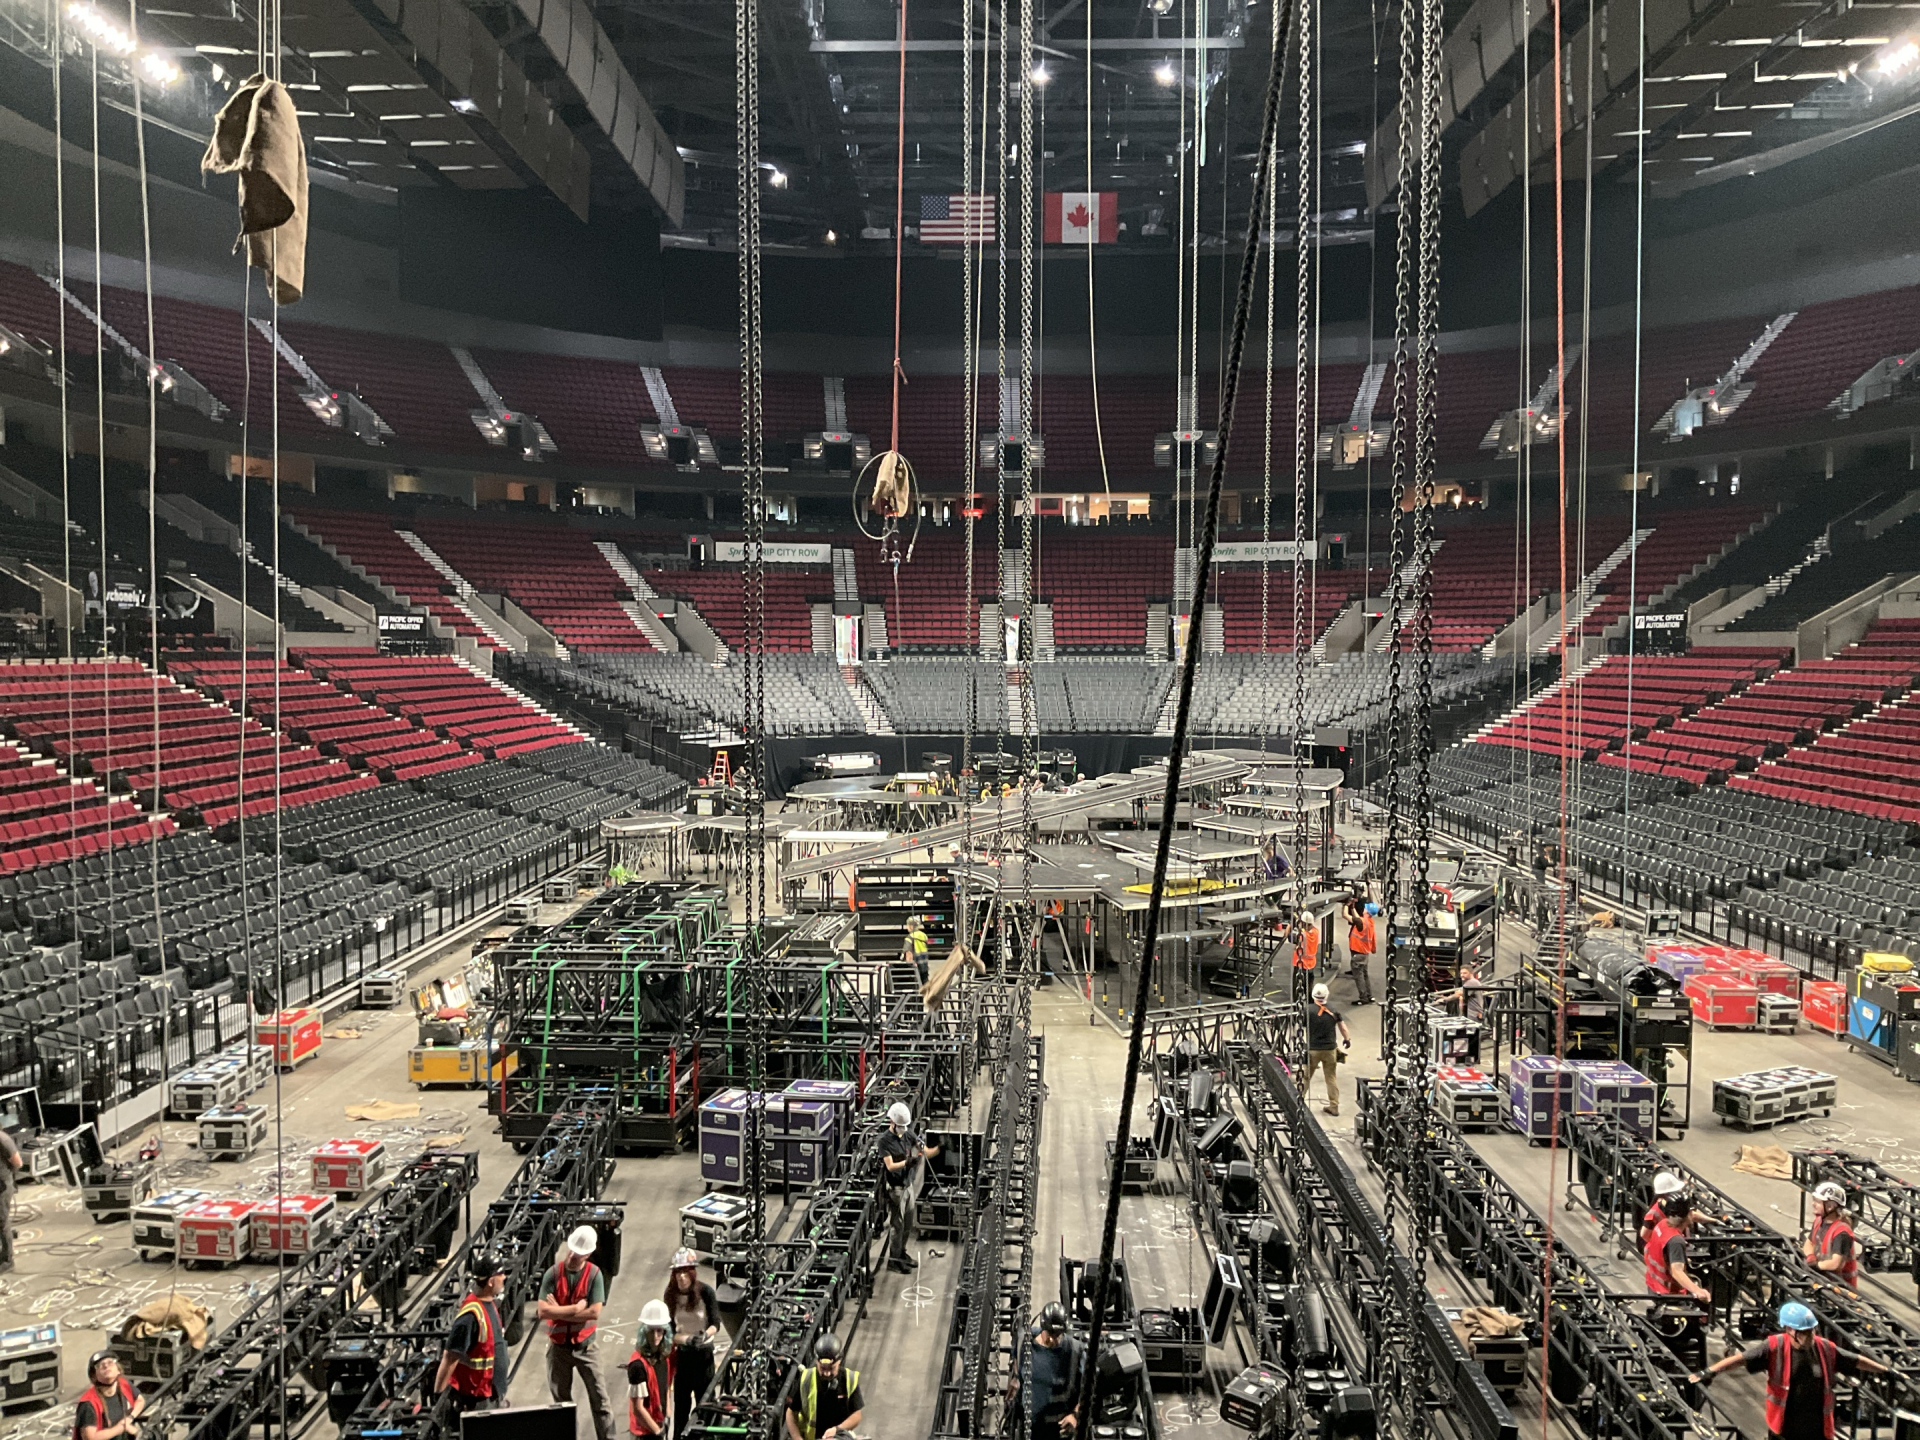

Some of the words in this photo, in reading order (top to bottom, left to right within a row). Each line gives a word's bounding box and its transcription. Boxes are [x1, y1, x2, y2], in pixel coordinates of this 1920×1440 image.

[728, 547, 753, 557] Sprie
[761, 548, 774, 557] RIP
[777, 548, 796, 557] CITY
[798, 549, 819, 557] ROW
[1213, 547, 1237, 557] Sprite
[1244, 547, 1259, 556] RIP
